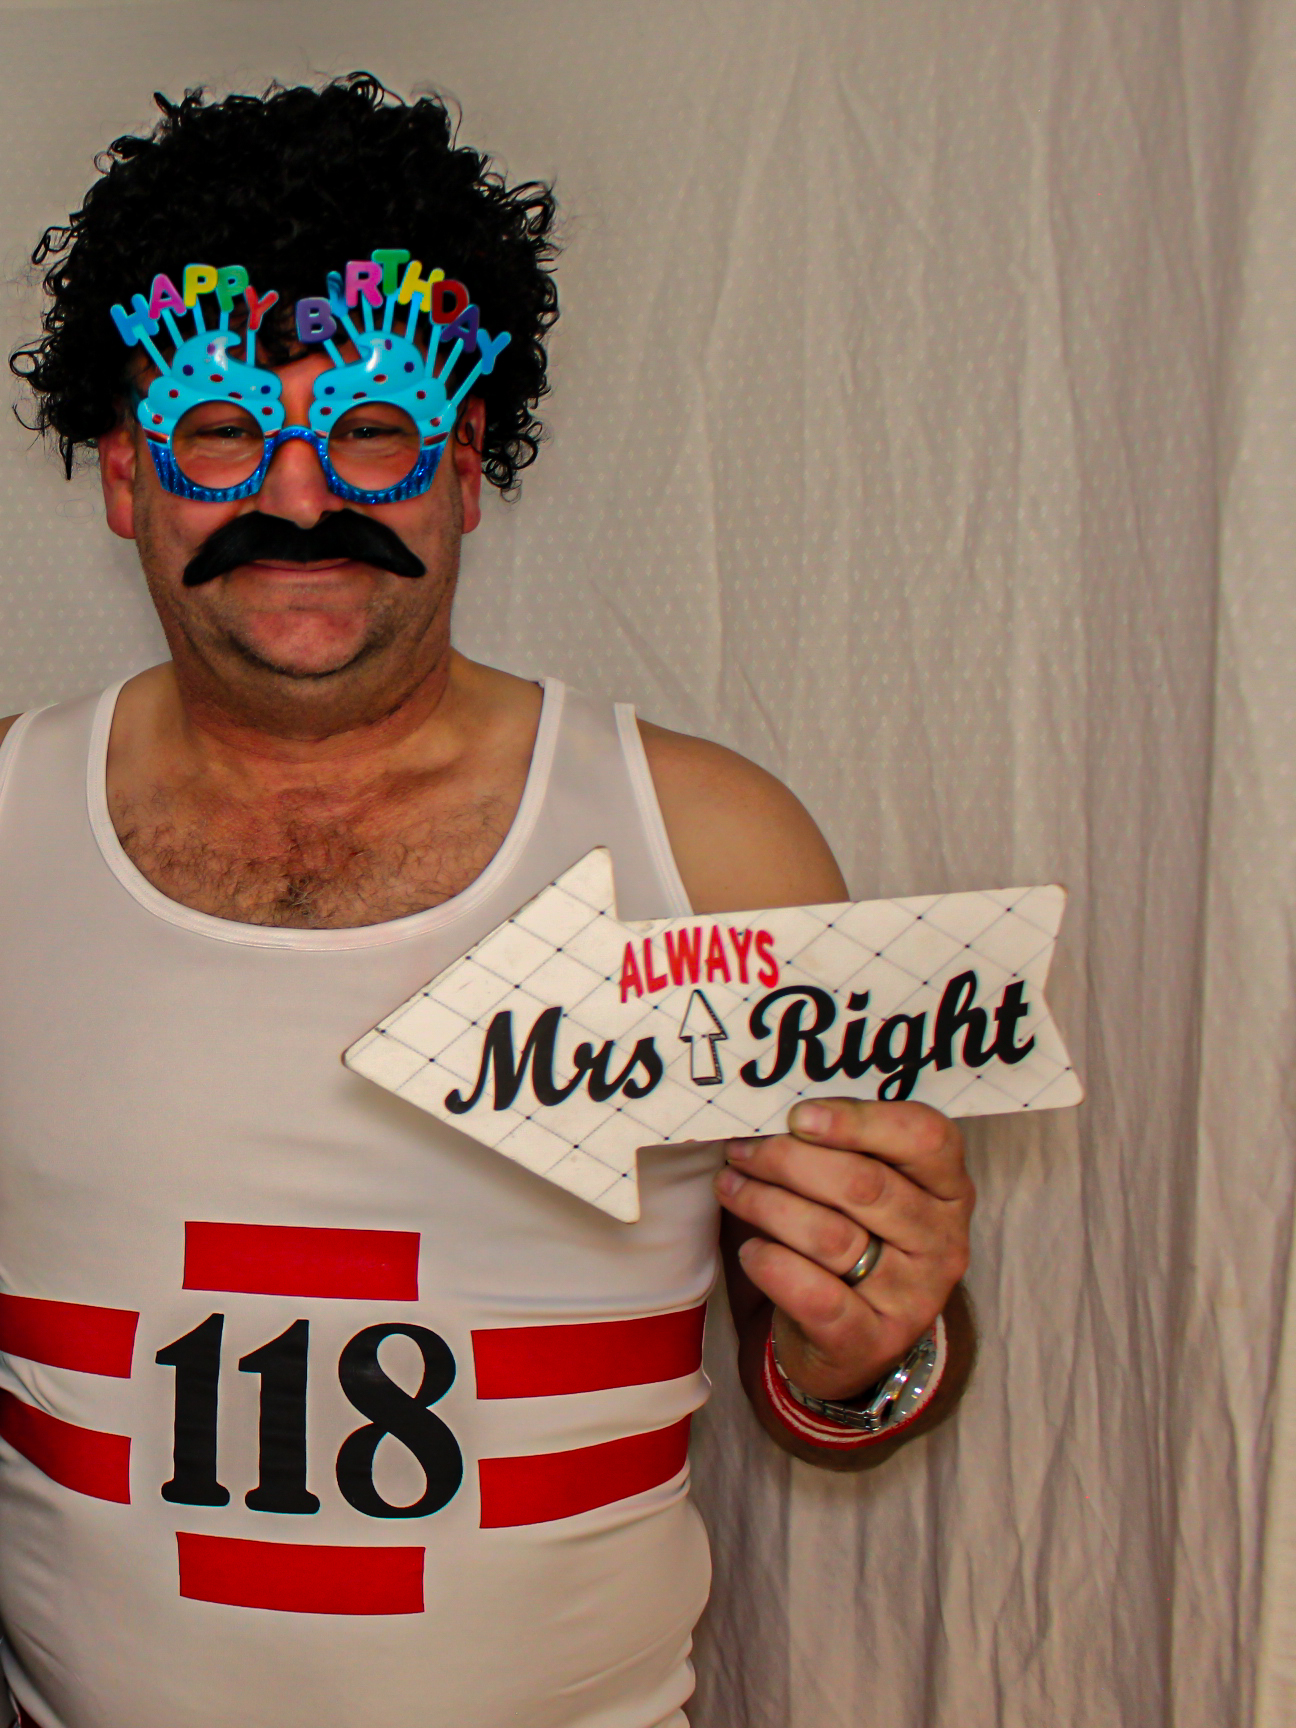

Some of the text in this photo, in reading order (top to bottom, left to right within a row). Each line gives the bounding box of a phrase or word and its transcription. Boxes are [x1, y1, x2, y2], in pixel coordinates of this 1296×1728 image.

[110, 248, 512, 375] HAPPY BIRTHDAY
[618, 925, 780, 1003] ALWAYS
[444, 969, 1037, 1115] Mrs Right
[154, 1312, 464, 1520] 118
